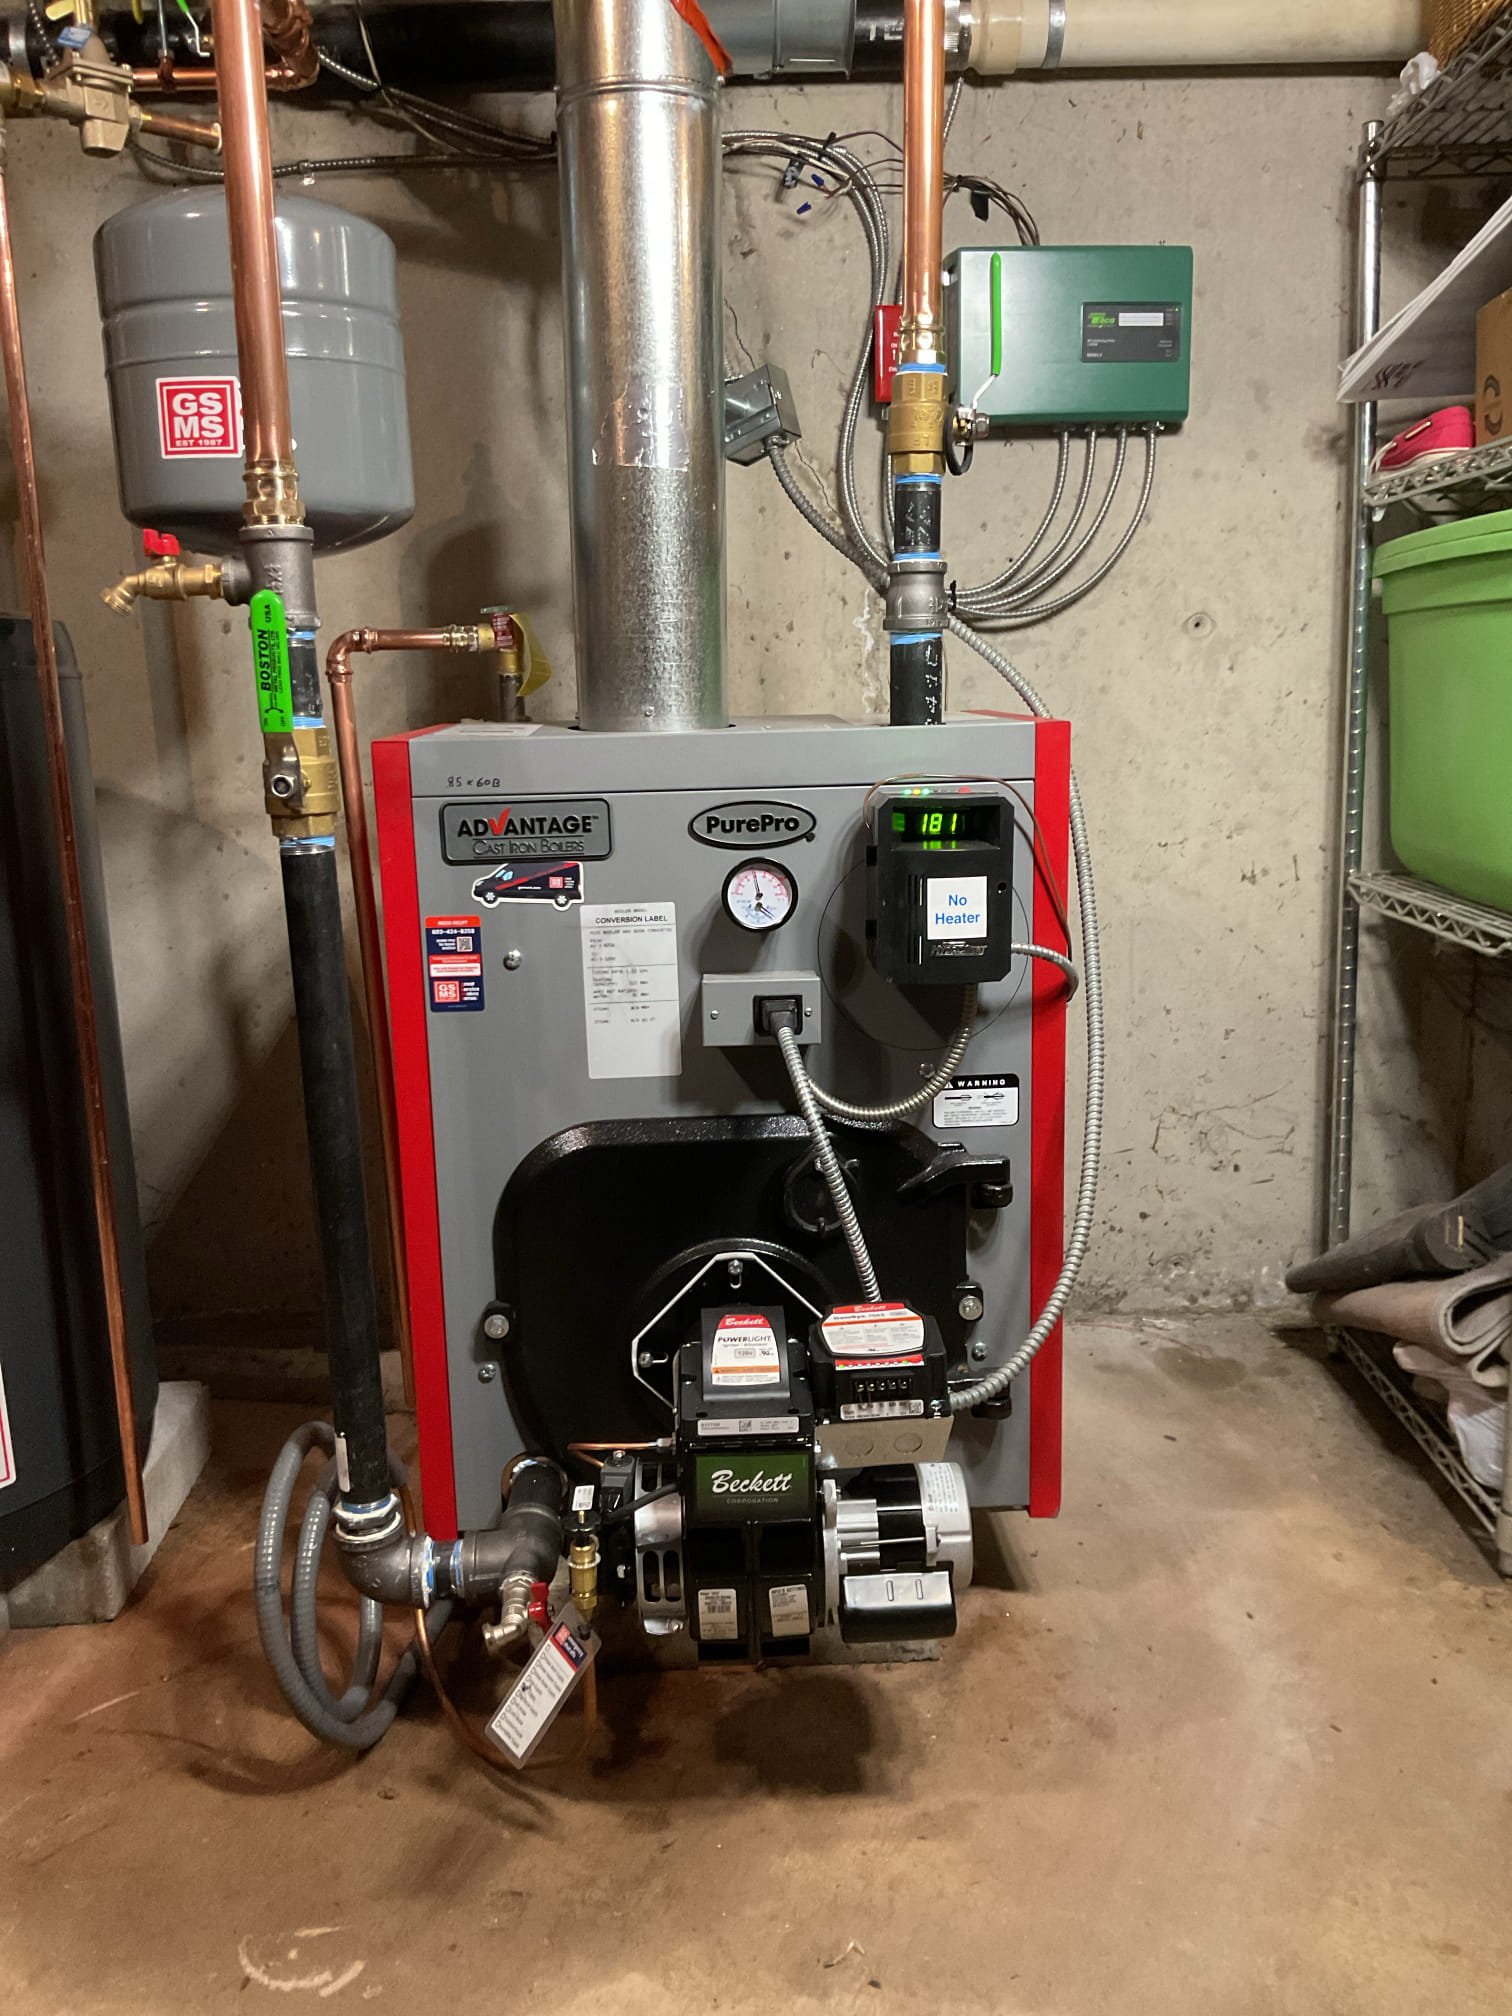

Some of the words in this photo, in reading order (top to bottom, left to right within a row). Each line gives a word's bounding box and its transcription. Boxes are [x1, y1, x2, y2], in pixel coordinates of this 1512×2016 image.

[172, 392, 223, 416] GS
[173, 415, 225, 439] MS
[264, 604, 272, 623] USA
[257, 629, 272, 692] BOSTON
[706, 814, 800, 833] PurePro
[922, 813, 957, 833] 181
[948, 894, 967, 907] No
[595, 916, 642, 924] CONVERSION
[935, 912, 980, 925] Heater
[957, 1079, 1006, 1087] WARNING
[725, 1318, 764, 1326] Beckett
[718, 1335, 771, 1343] POWERLIGHT
[711, 1469, 793, 1493] Beckett
